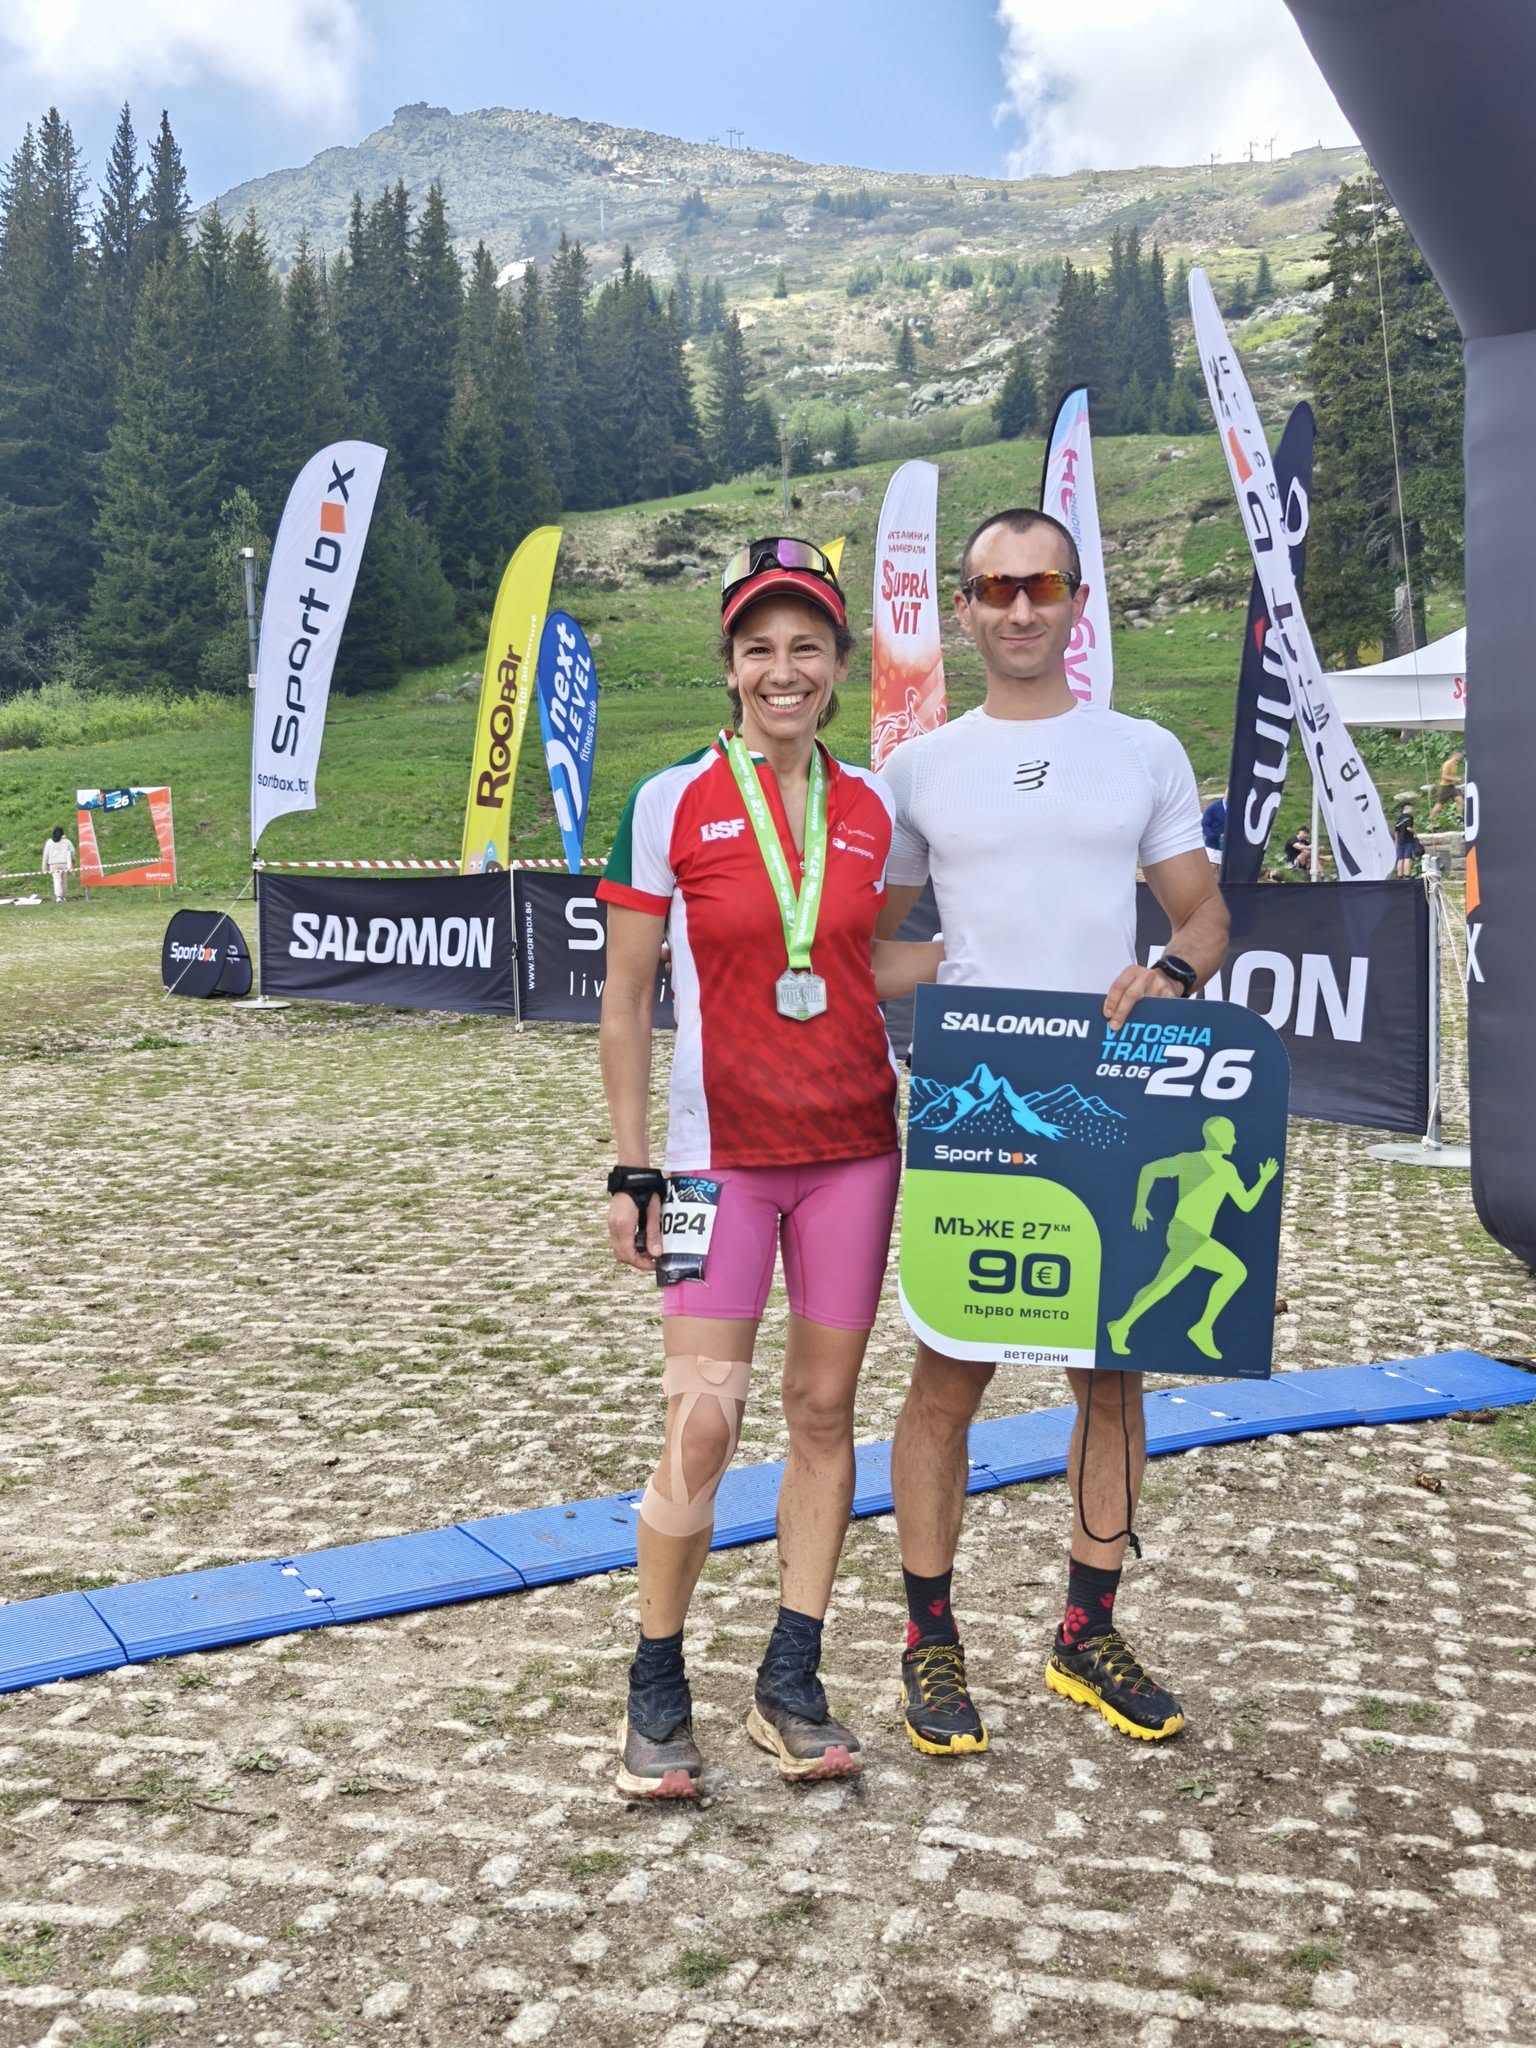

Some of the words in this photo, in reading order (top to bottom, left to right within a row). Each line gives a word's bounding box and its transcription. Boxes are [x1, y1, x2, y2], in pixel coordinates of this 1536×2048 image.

[881, 559, 929, 602] SUPRA
[271, 587, 330, 757] Sport
[550, 622, 576, 732] next
[567, 654, 591, 752] LEVEL
[580, 723, 594, 761] fitness
[114, 795, 129, 809] 26
[170, 941, 197, 962] Sport
[289, 912, 495, 969] SALOMON
[525, 901, 535, 990] WWW.SPORTBOX.BG
[570, 971, 605, 998] liv
[941, 1012, 1090, 1038] SALOMON
[1101, 1041, 1168, 1063] TRAIL
[1096, 1063, 1151, 1079] 06.06
[1144, 1045, 1255, 1100] 26
[934, 1145, 993, 1163] Sport
[696, 1180, 718, 1193] 26
[660, 1212, 706, 1235] 024
[934, 1216, 1014, 1239] МЪЖЕ
[964, 1304, 1014, 1318] първо
[1020, 1308, 1069, 1320] място
[1004, 1350, 1069, 1363] ветерани
